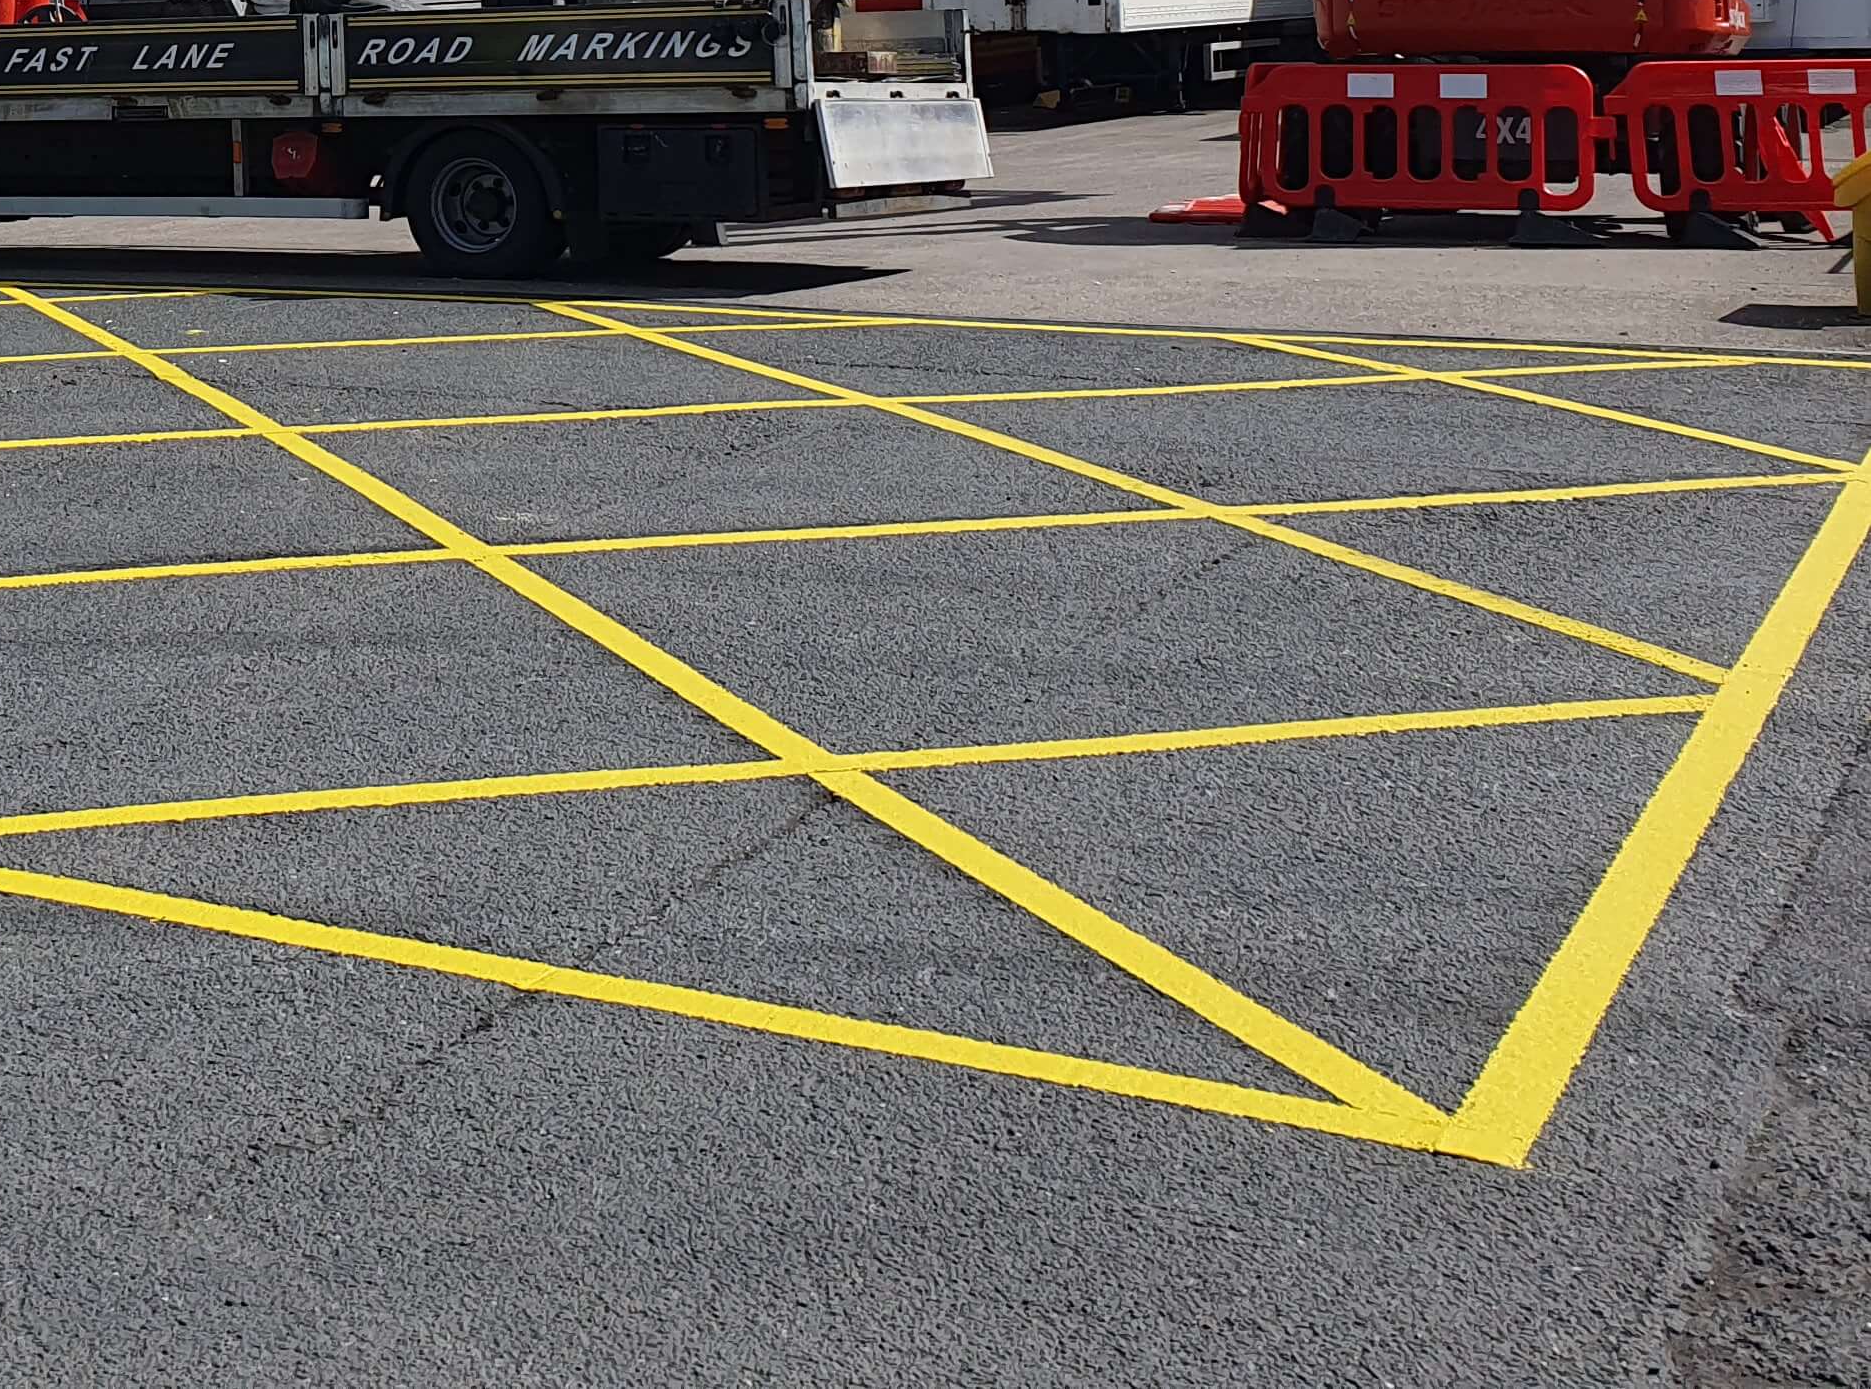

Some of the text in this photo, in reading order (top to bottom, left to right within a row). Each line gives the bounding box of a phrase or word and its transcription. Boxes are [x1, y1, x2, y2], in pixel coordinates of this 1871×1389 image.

[3, 42, 236, 74] FAST LANE
[357, 29, 753, 66] ROAD MARKINGS
